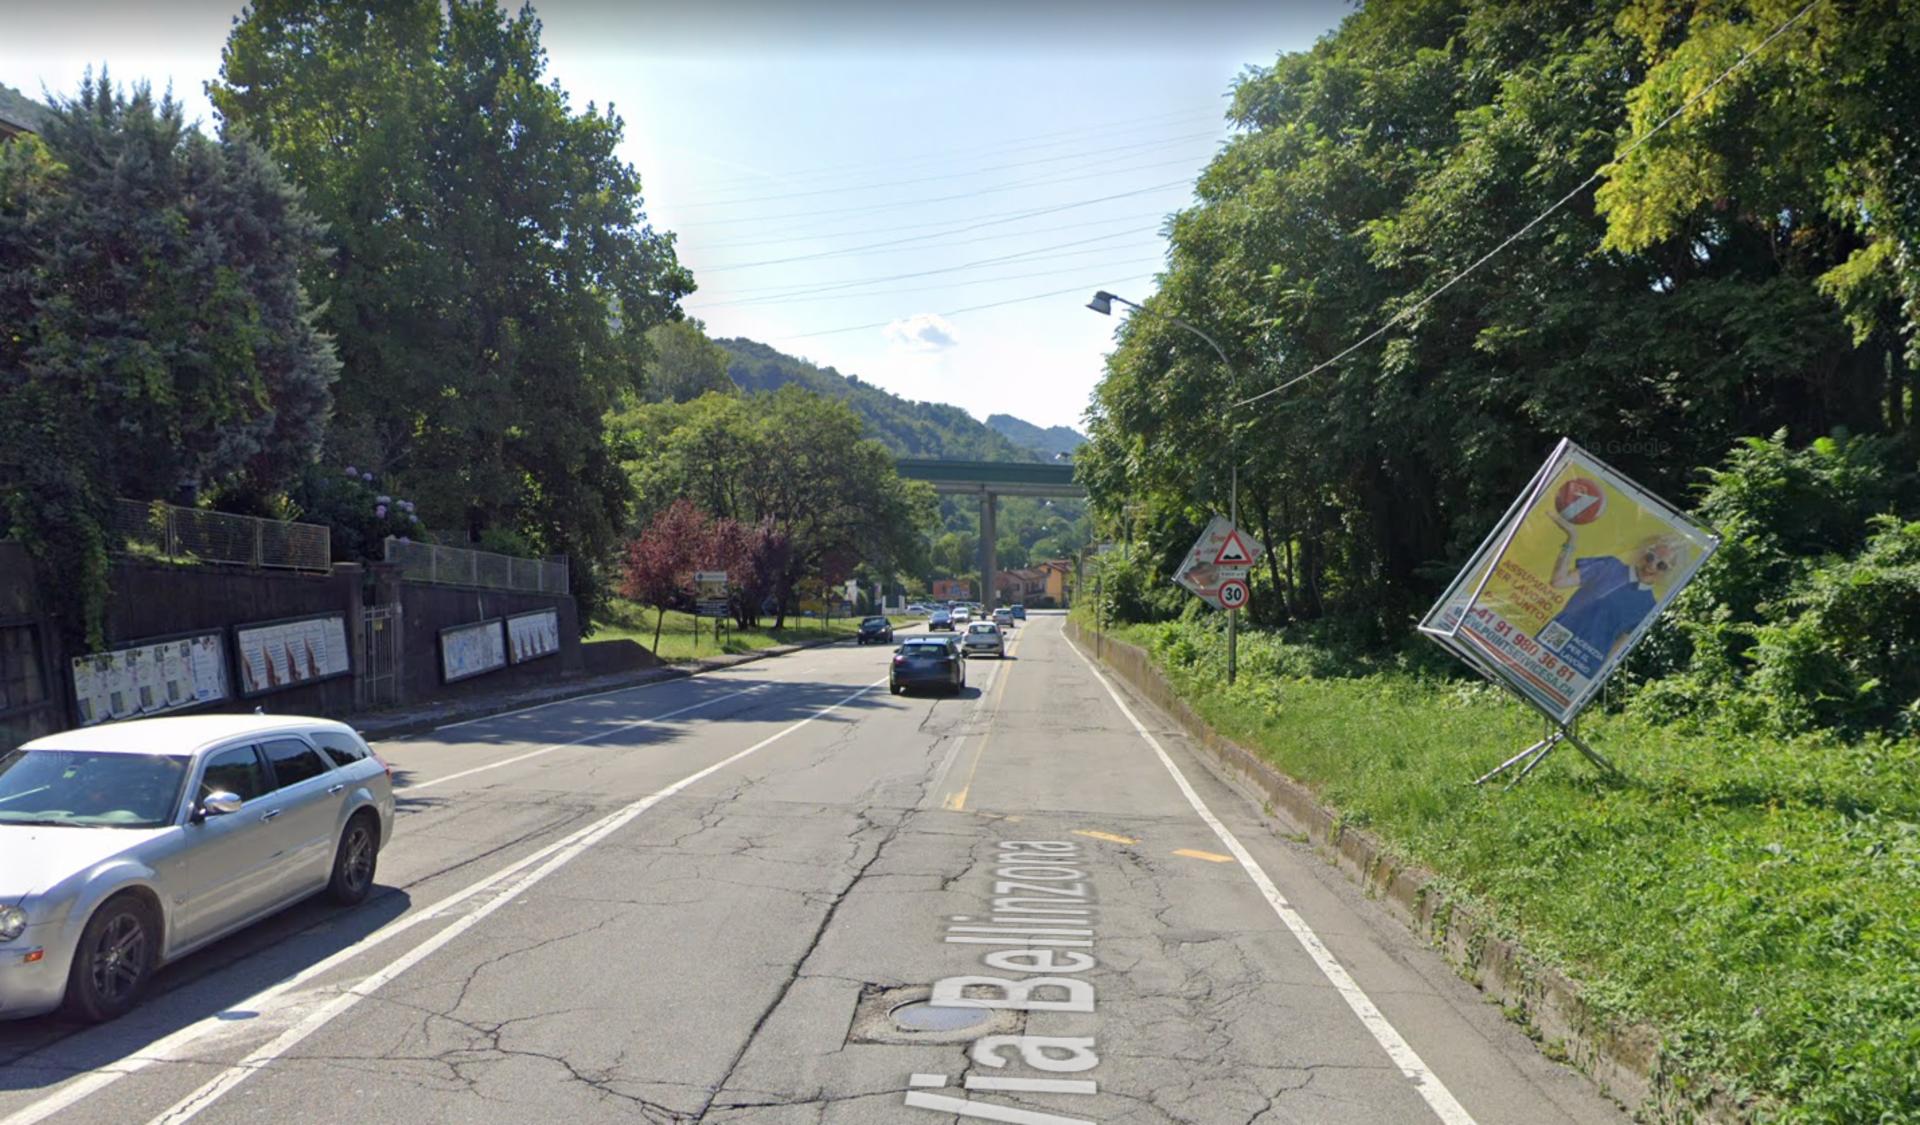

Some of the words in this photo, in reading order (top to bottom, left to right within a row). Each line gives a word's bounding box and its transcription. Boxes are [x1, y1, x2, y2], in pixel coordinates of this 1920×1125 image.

[1225, 587, 1242, 601] 30
[1502, 559, 1565, 605] ASSUMIAMO
[1494, 620, 1513, 637] 91
[1512, 633, 1540, 657] 980
[1538, 651, 1559, 670] 36
[1556, 664, 1577, 682] 81
